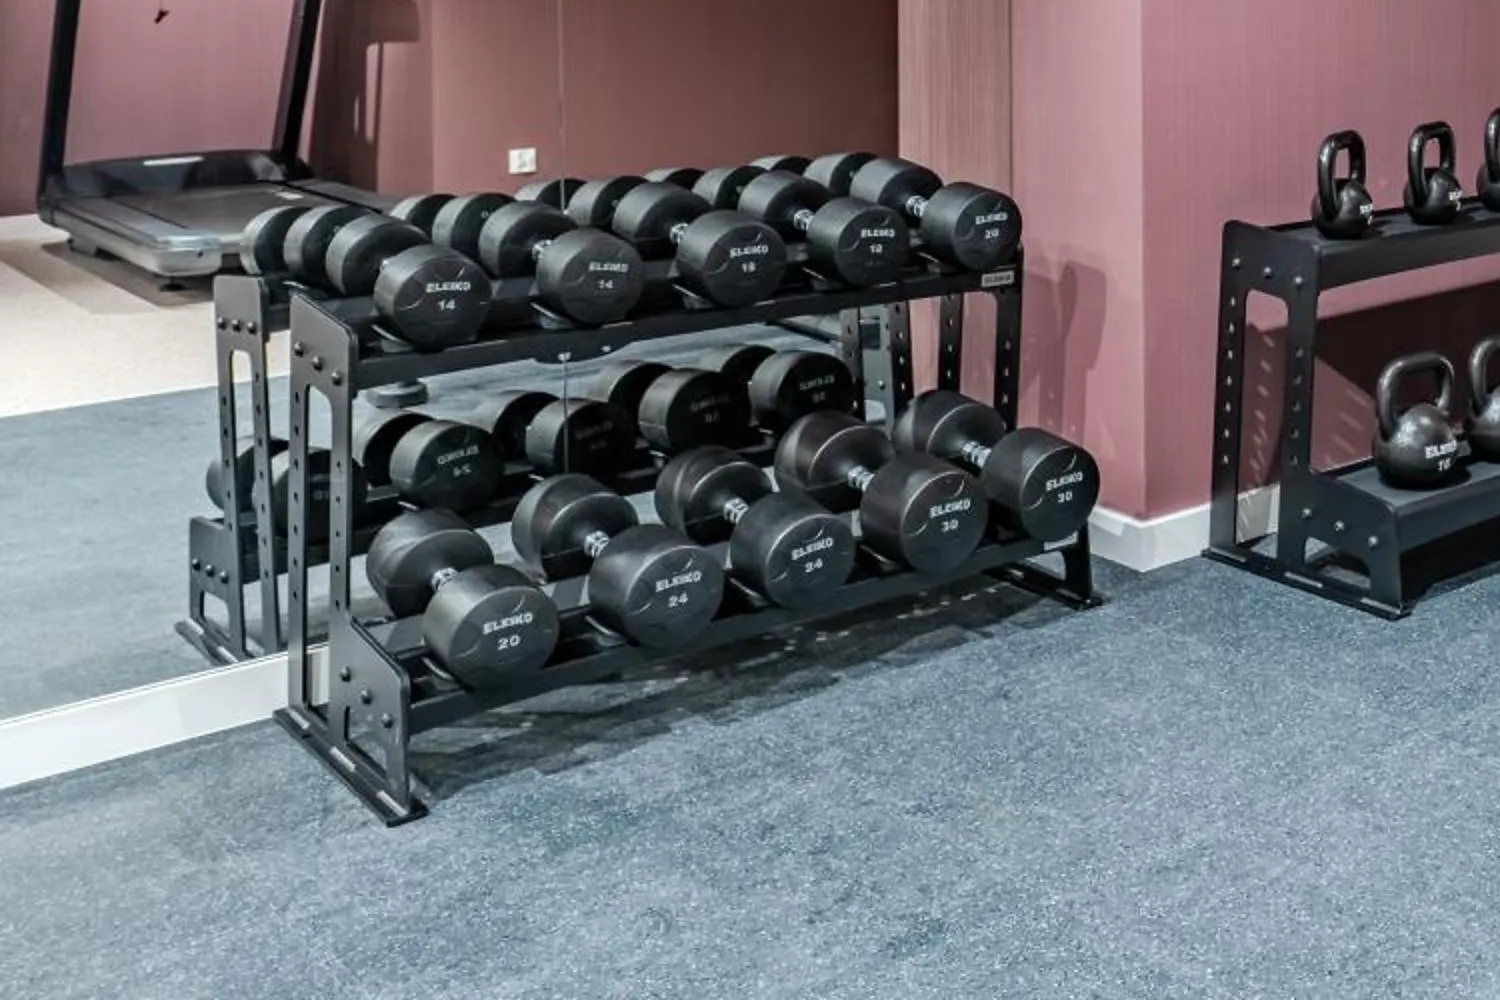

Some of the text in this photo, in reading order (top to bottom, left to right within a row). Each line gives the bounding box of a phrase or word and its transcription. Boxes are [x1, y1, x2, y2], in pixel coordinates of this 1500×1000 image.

[437, 299, 455, 311] 14
[791, 537, 833, 561] ELEIKO
[655, 570, 702, 593] ELEIKO
[483, 612, 533, 635] ELEIKO
[497, 635, 521, 651] 20
